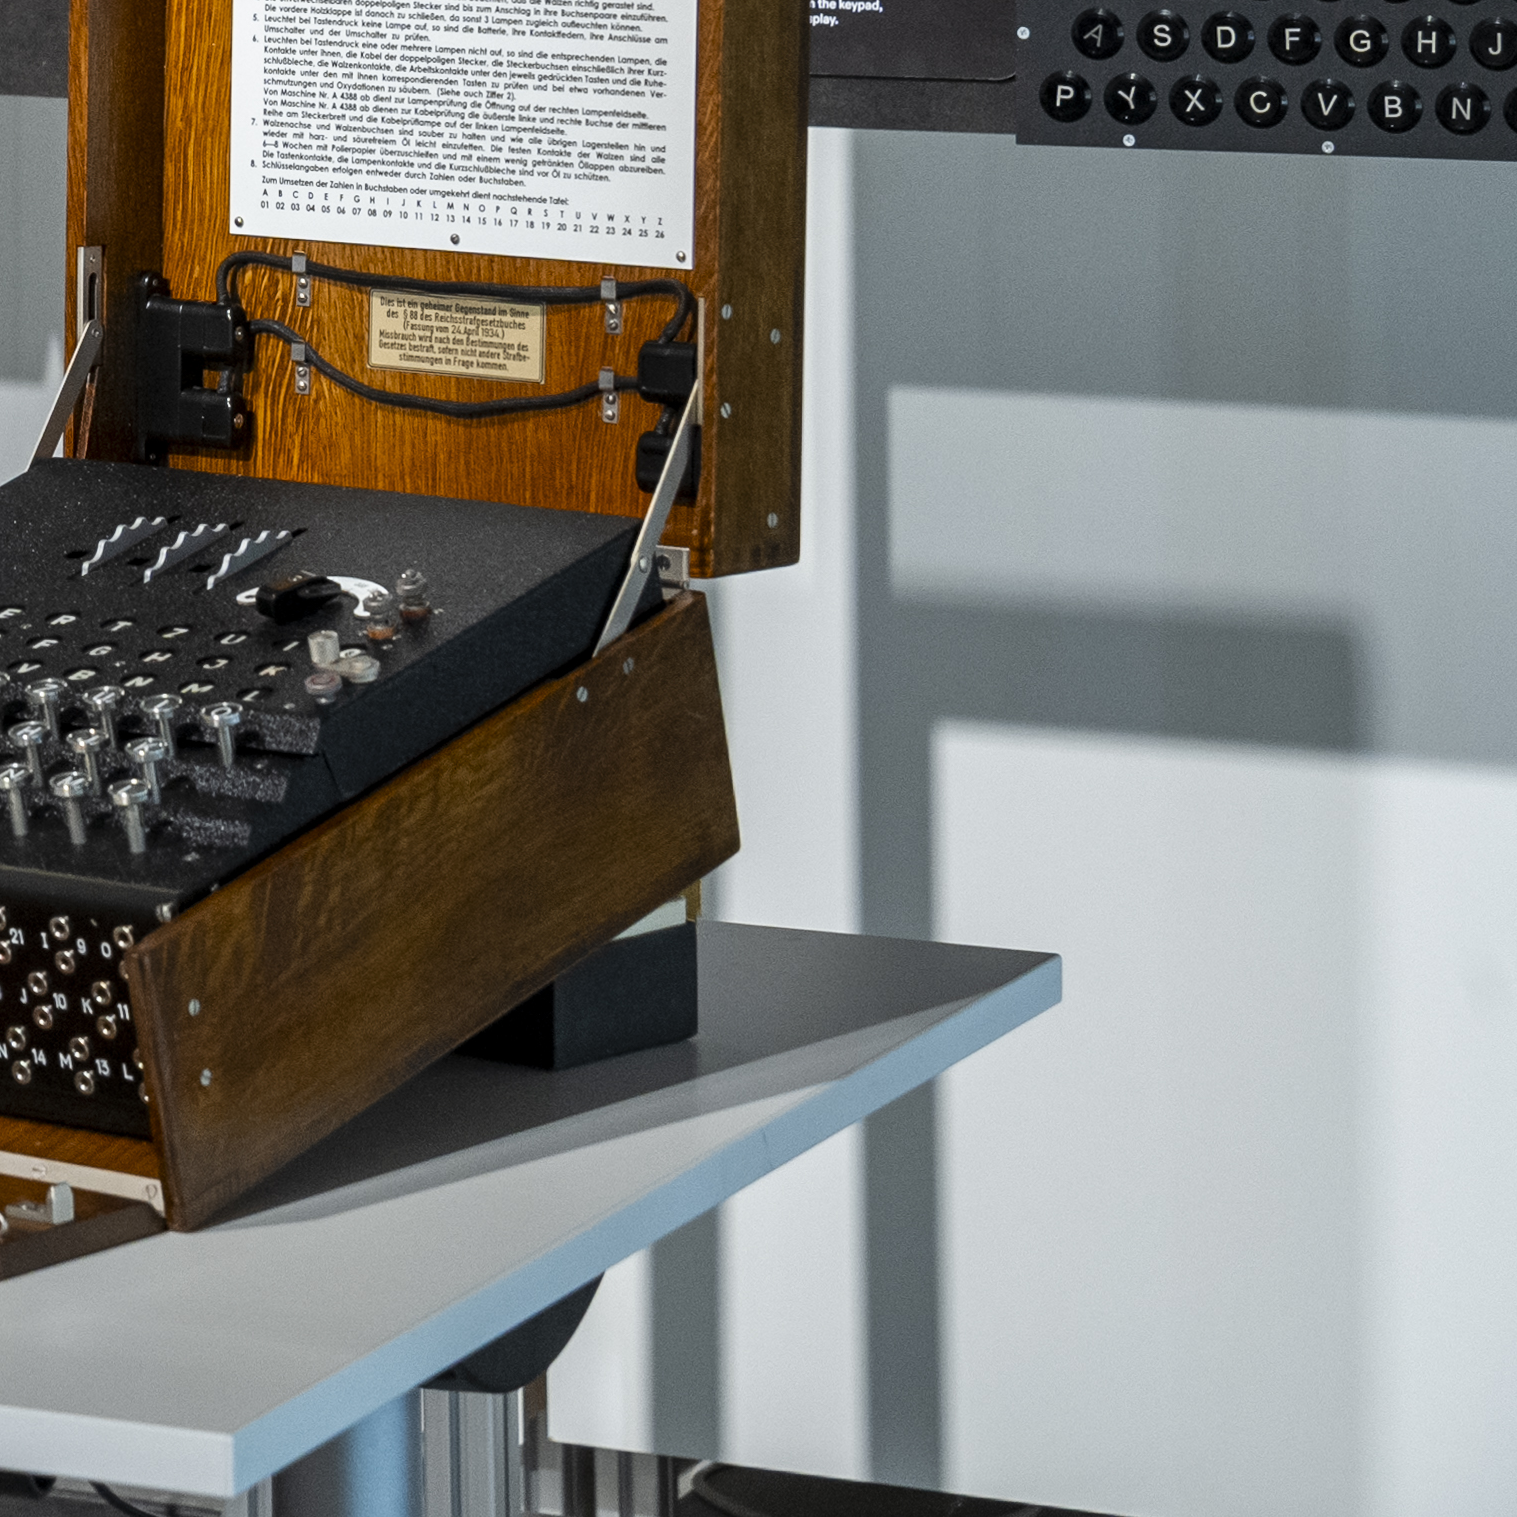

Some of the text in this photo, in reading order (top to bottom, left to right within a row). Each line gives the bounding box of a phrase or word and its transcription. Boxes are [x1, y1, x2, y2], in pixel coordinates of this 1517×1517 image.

[1084, 24, 1501, 55] A S D F G H J
